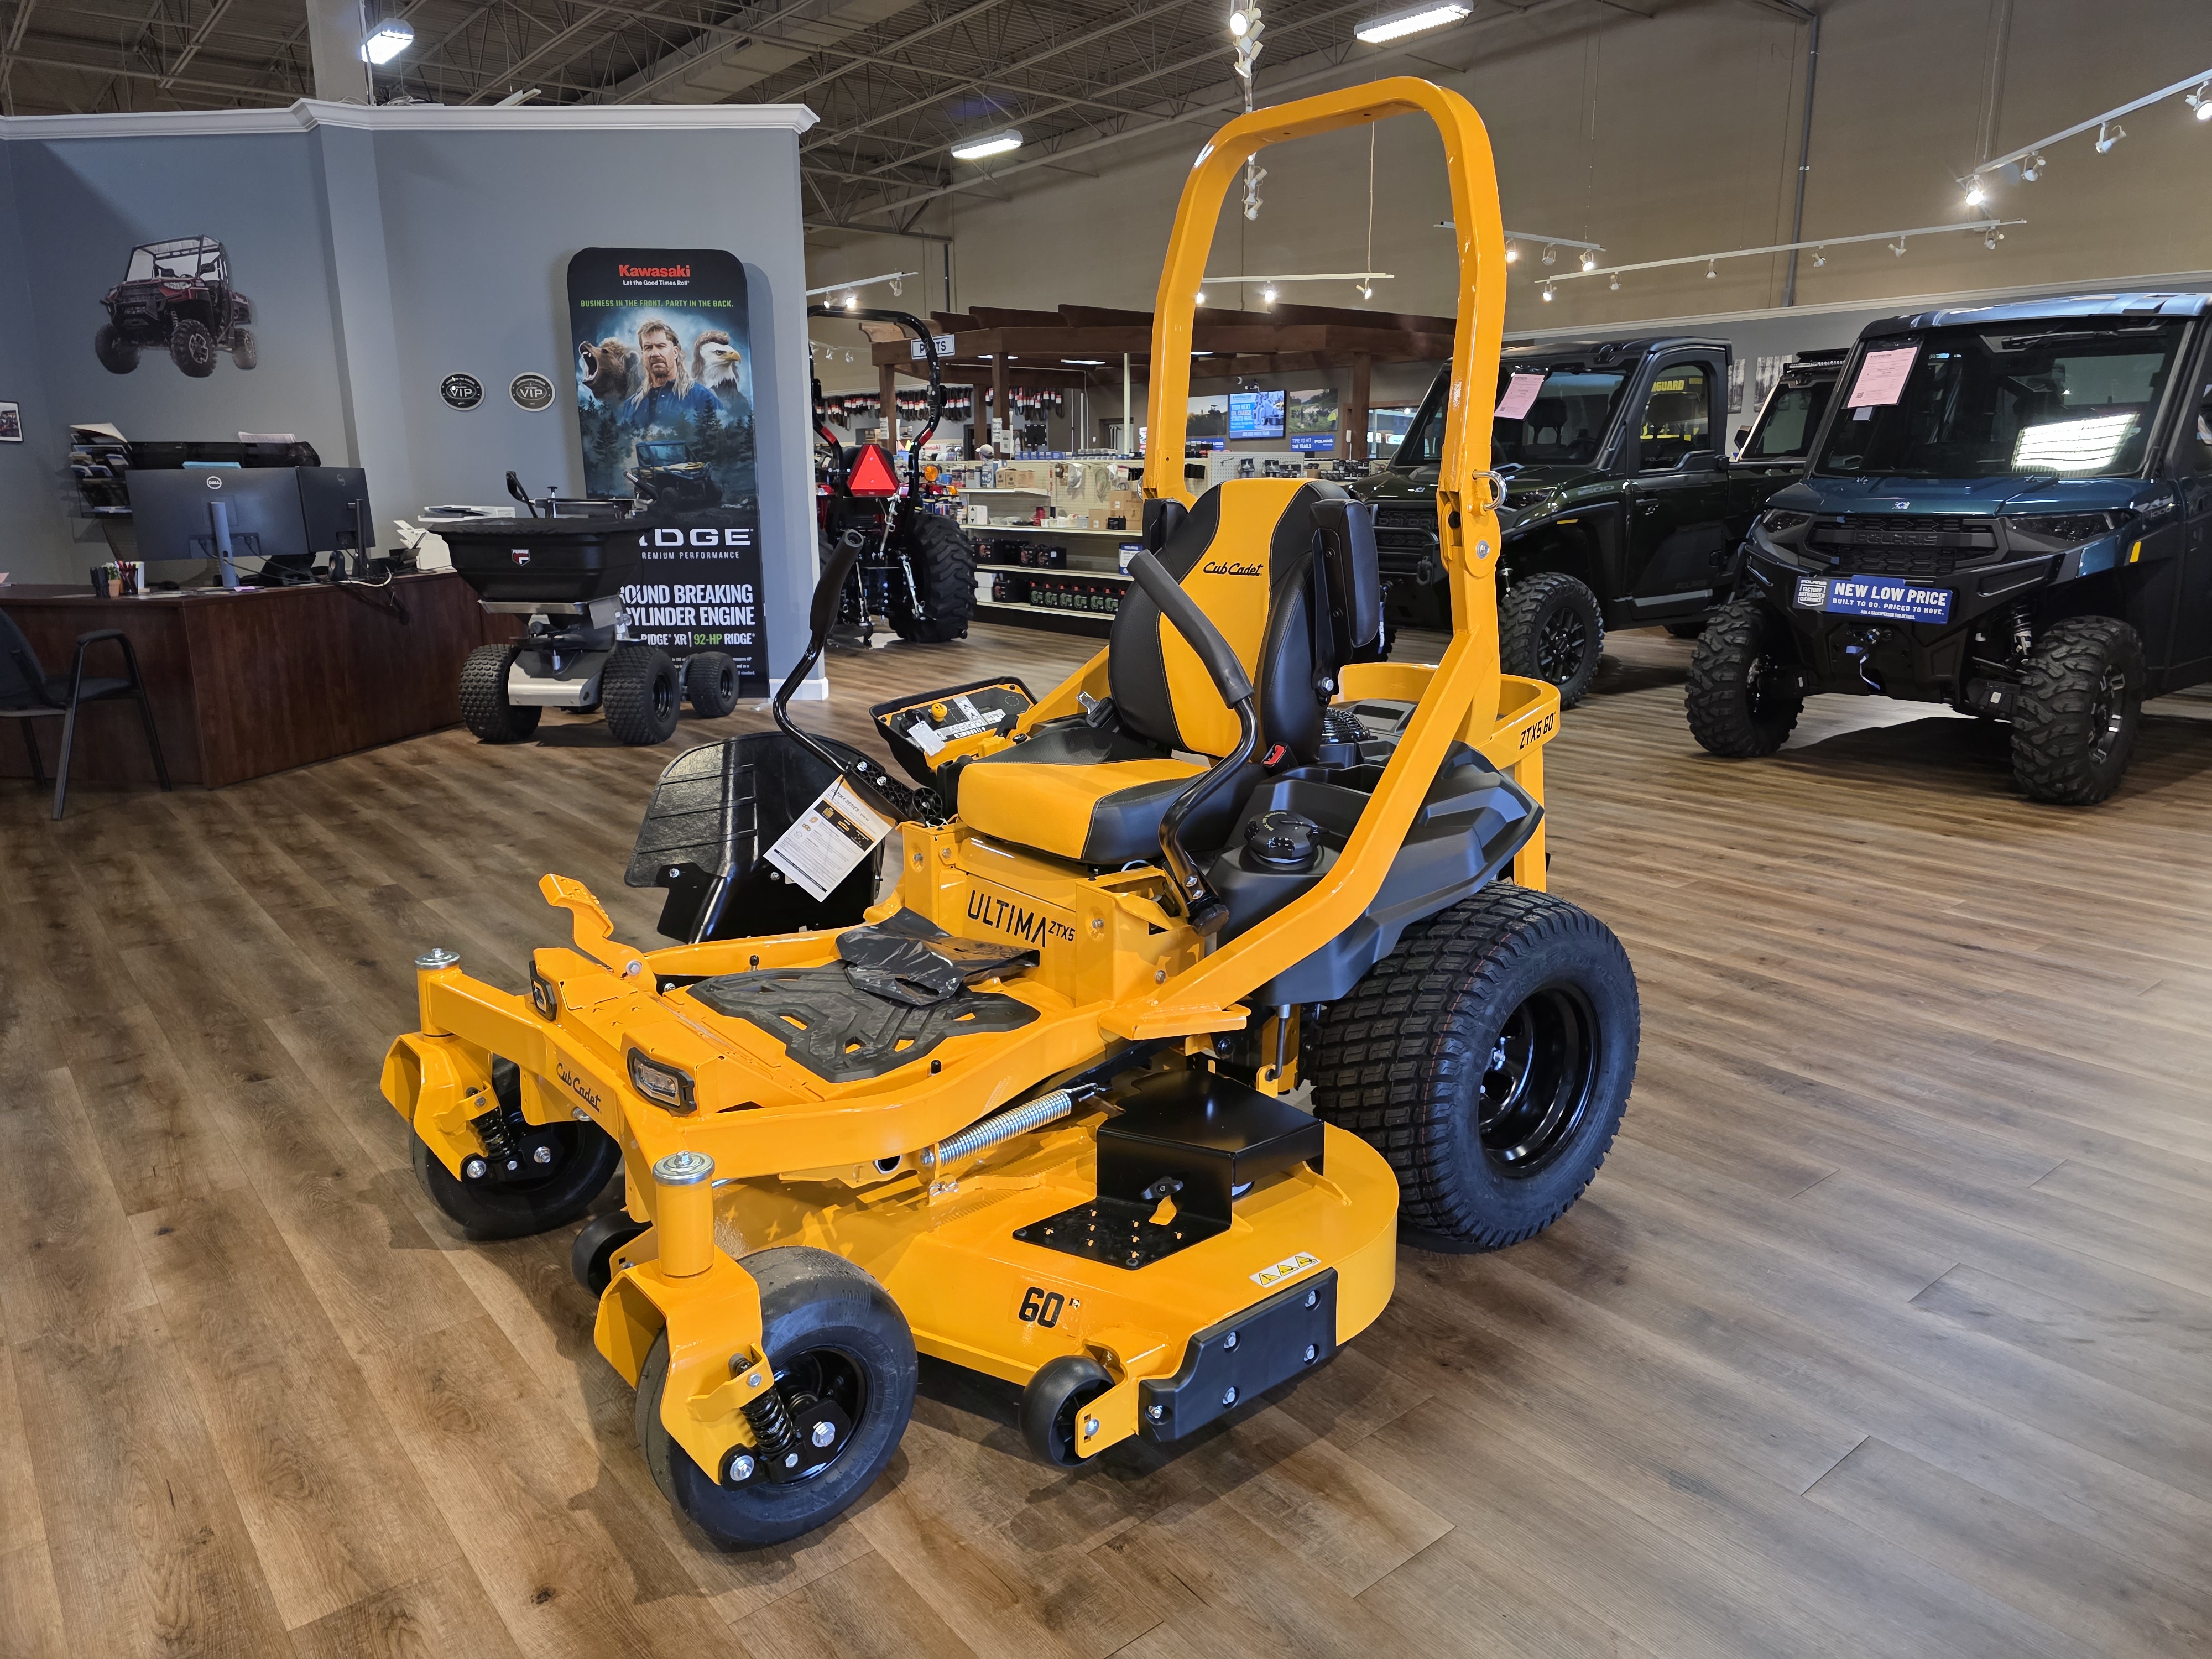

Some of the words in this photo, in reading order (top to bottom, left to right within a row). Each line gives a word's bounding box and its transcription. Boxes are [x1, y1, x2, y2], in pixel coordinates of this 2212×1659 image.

[619, 264, 691, 278] Kawasaki
[920, 341, 946, 353] PTS
[450, 388, 472, 397] VIP
[520, 389, 542, 398] VIP
[641, 551, 675, 560] REMIUM
[679, 551, 740, 559] PERFORMANCE
[1203, 561, 1228, 575] Cub
[1228, 562, 1264, 576] Cadet
[674, 583, 753, 604] BREAKING
[1834, 582, 1869, 598] NEW
[1871, 586, 1906, 602] LOW
[1907, 589, 1948, 606] PRICE
[1832, 597, 1855, 606] BUILT
[1884, 603, 1911, 612] PRICED
[1923, 607, 1944, 615] MOVE.
[700, 606, 756, 626] ENGINE
[674, 633, 687, 645] XR
[693, 633, 723, 645] 92-HP
[724, 633, 753, 645] RIDGE
[1519, 719, 1543, 750] ZTX5
[844, 800, 860, 813] SERIES
[967, 890, 1046, 948] ULTIMA
[1048, 920, 1076, 942] ZTX5
[556, 1062, 572, 1087] Cub
[572, 1077, 601, 1113] Cadet
